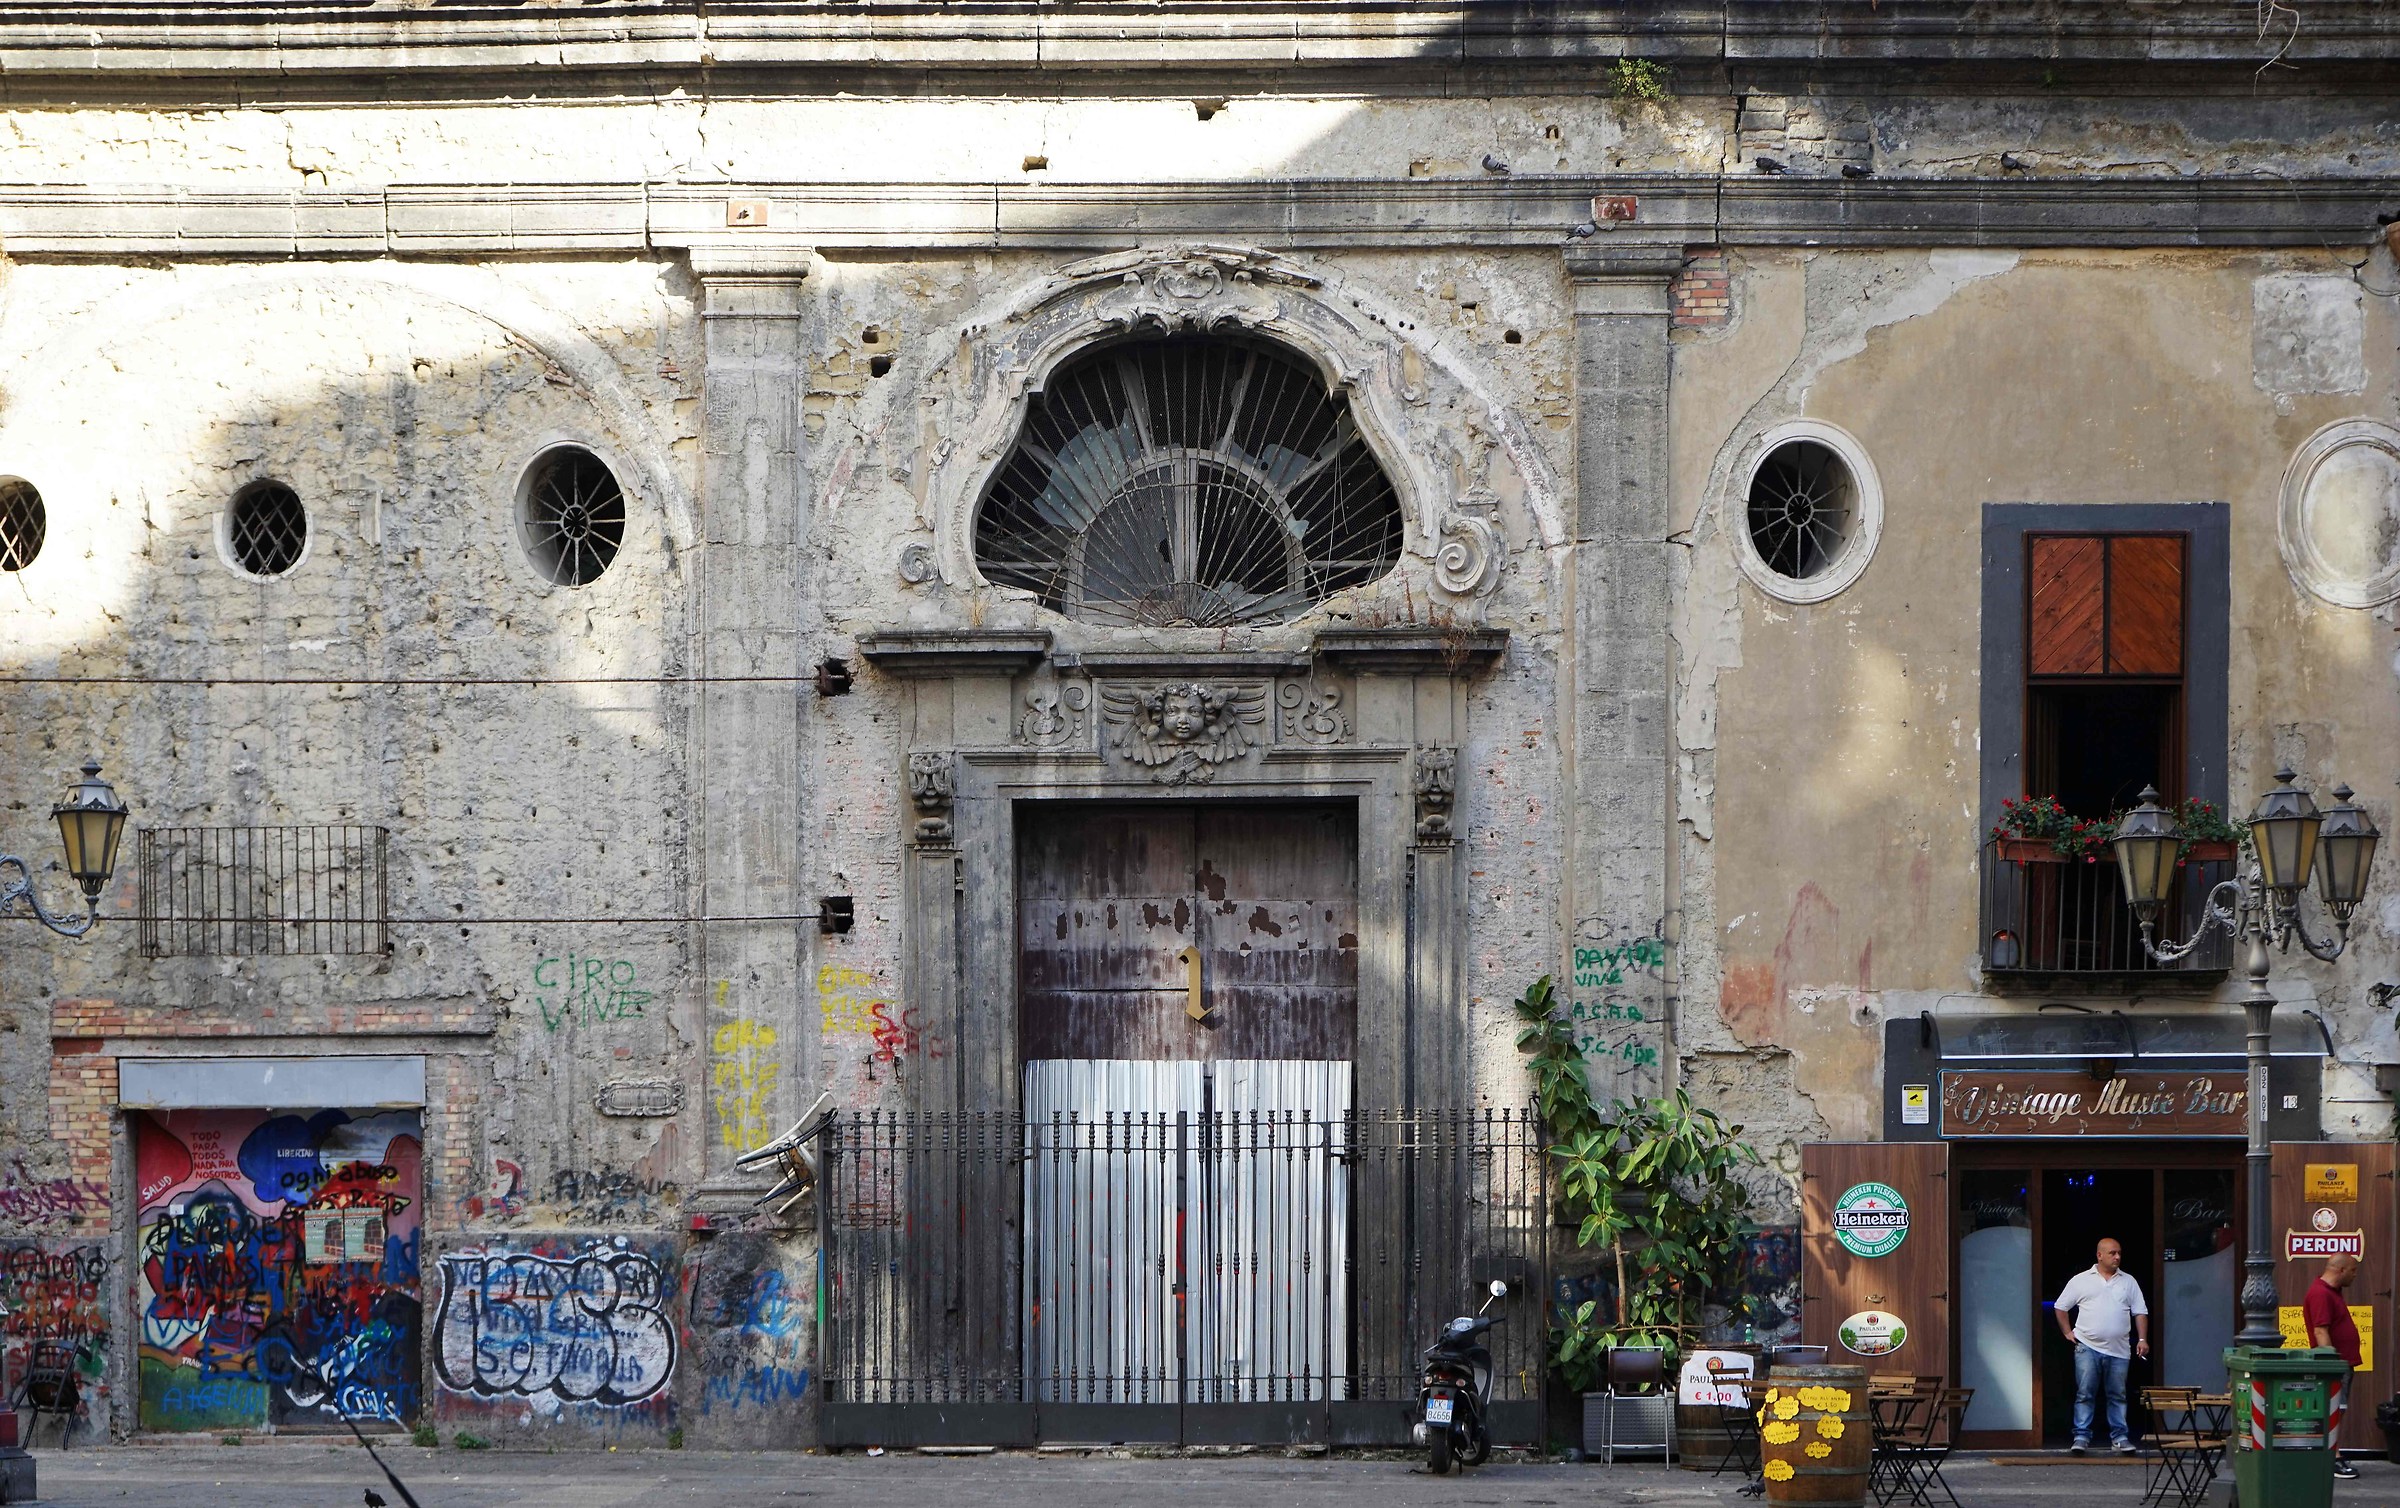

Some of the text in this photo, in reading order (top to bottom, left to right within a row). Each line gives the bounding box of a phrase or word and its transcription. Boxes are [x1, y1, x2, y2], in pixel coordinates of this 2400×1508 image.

[534, 953, 635, 991] CIRO
[1575, 969, 1623, 987] VIVE
[537, 990, 652, 1033] VIVE
[1954, 1083, 2082, 1124] Vintage
[2088, 1078, 2176, 1116] Music
[2183, 1076, 2246, 1115] Bar
[191, 1130, 221, 1142] TODO
[193, 1142, 219, 1151] PARA
[192, 1150, 226, 1160] TODOS
[194, 1159, 235, 1171] NADA PARA
[195, 1169, 241, 1181] NOSOTROS
[141, 1175, 172, 1201] SALUD
[1842, 1185, 1901, 1206] HEINEKEN PILSENER
[1968, 1199, 2023, 1220] Vintage
[2172, 1199, 2225, 1219] Bar
[1838, 1212, 1906, 1226] Heineken
[1843, 1233, 1900, 1254] PREMIUM QUALITY
[2292, 1237, 2358, 1252] PERONI
[2281, 1309, 2304, 1320] SABA
[1695, 1392, 1732, 1402] € 1,00
